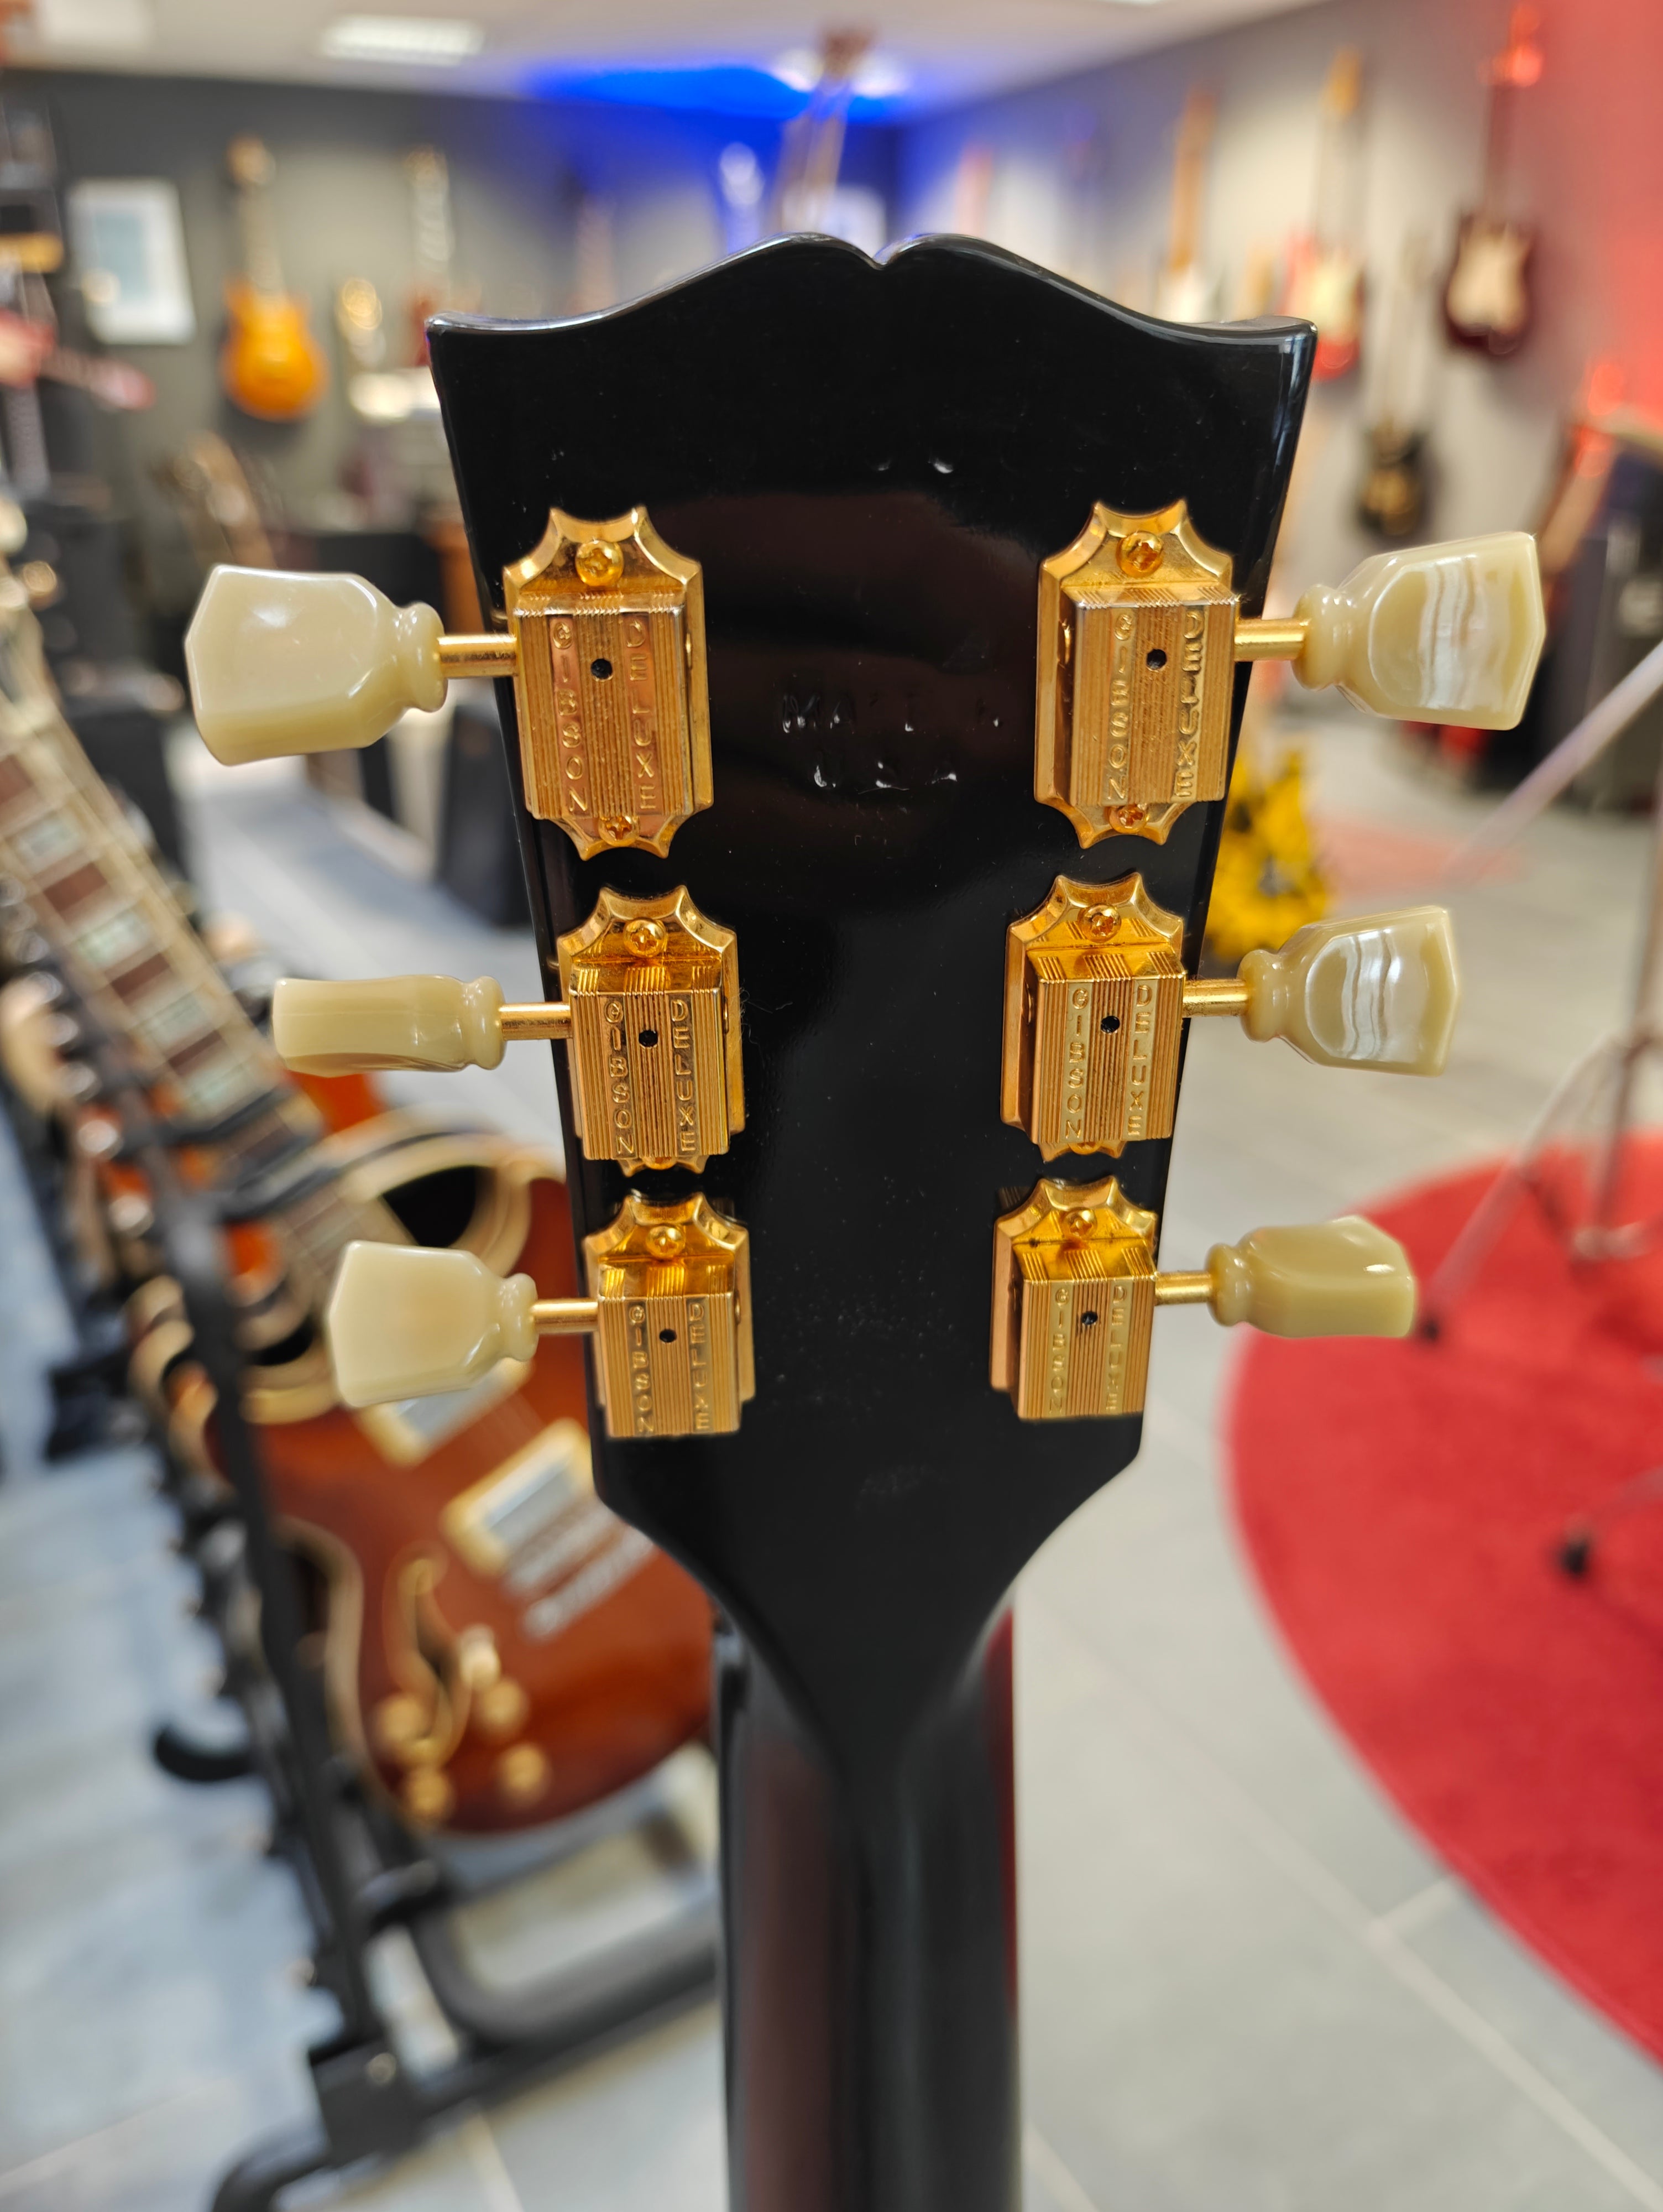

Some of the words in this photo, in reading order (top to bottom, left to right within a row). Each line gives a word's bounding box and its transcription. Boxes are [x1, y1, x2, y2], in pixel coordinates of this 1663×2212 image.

[552, 622, 588, 812] GIBSON
[625, 619, 657, 810] DELUXE
[1107, 613, 1135, 801] GIBSON
[1175, 611, 1205, 797] DELUXE
[603, 1000, 635, 1155] GIBSON
[671, 999, 697, 1152] DELUXE
[1064, 988, 1089, 1139] GIBSON
[1128, 985, 1153, 1136] DELUXE
[629, 1305, 655, 1433] GIBSON
[689, 1302, 710, 1431] DELUXE
[1049, 1287, 1069, 1414] GIBSON
[1106, 1285, 1128, 1412] DELUXE
